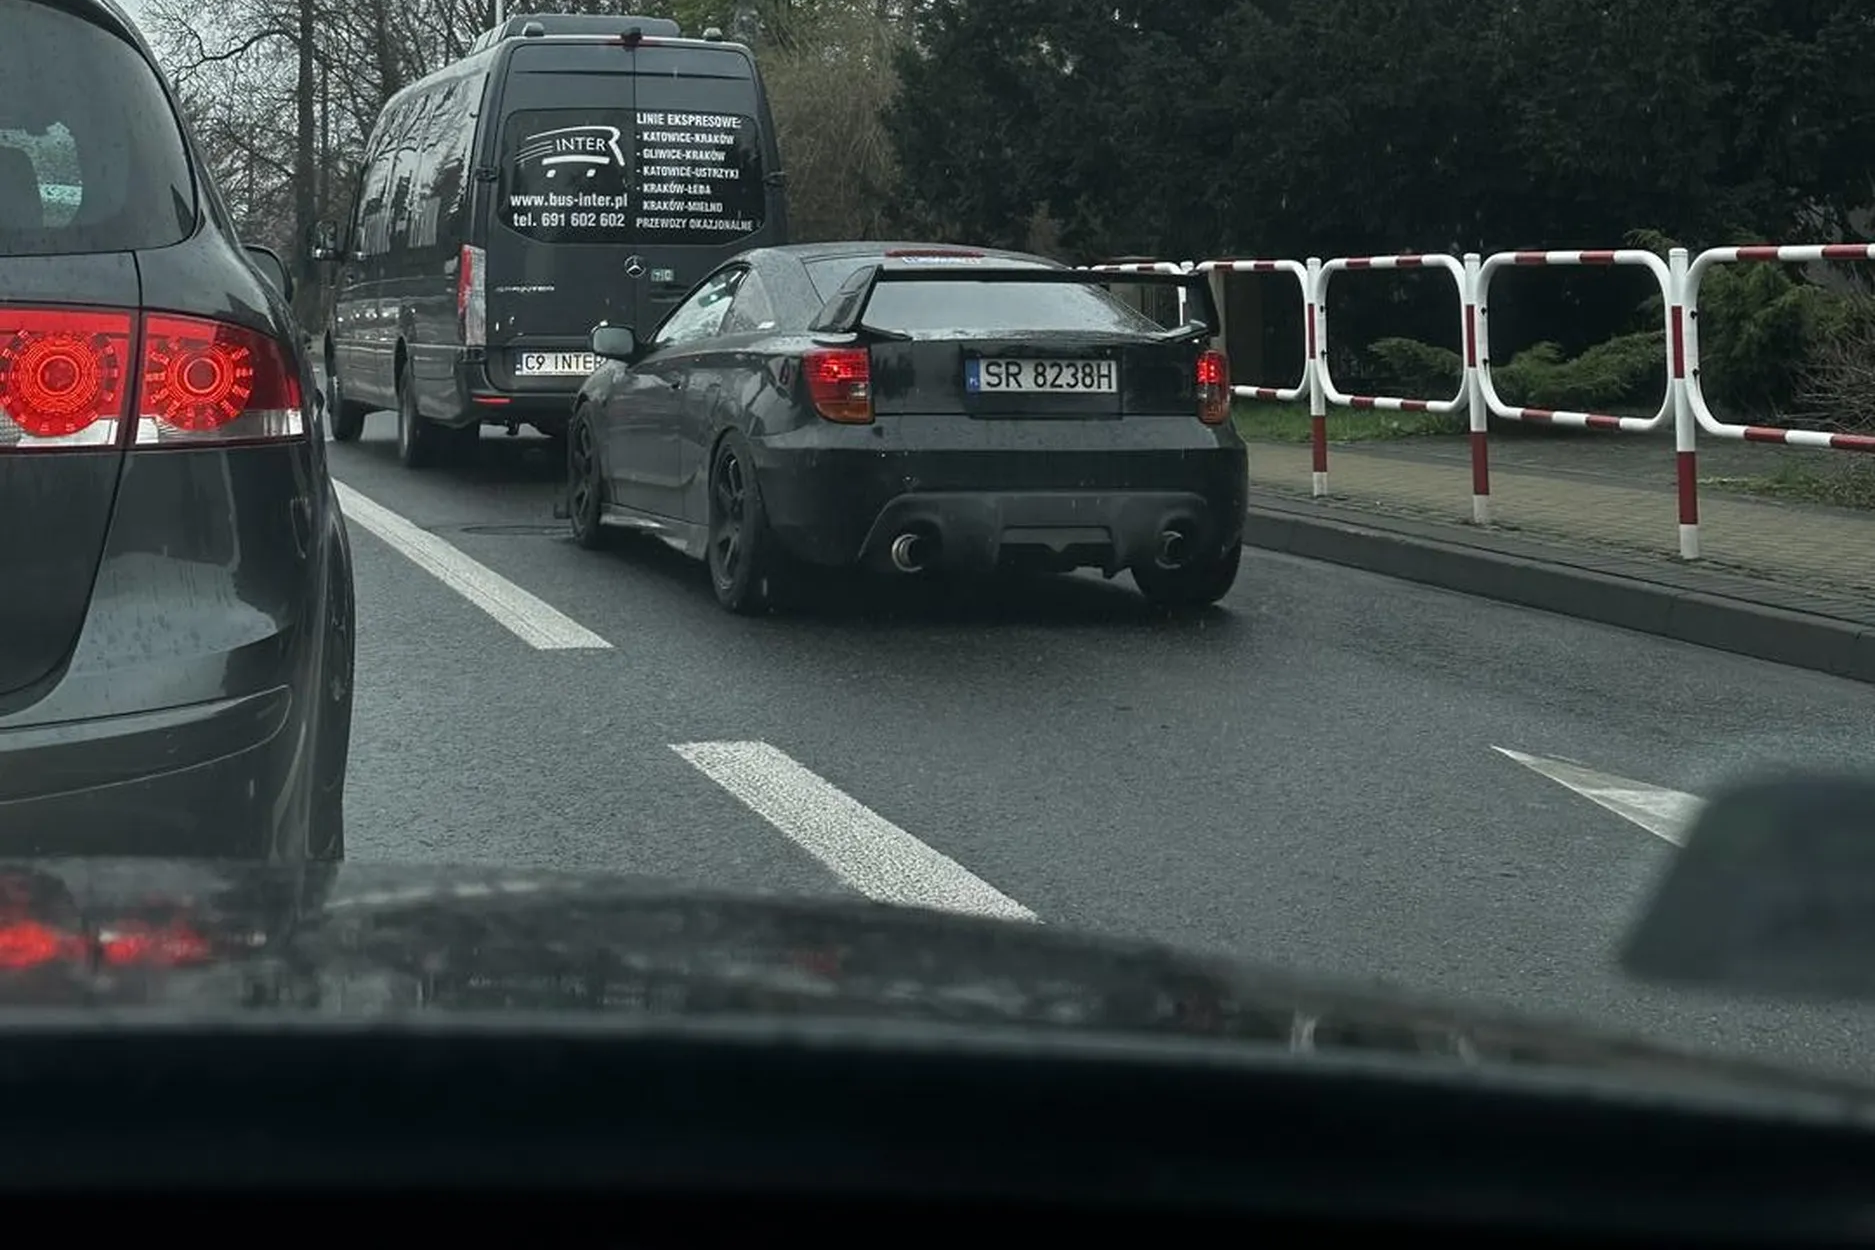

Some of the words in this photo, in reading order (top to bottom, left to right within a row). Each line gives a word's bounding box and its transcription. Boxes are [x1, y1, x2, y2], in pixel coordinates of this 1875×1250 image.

[636, 112, 664, 126] LINIE
[556, 137, 606, 151] INTER
[510, 192, 628, 210] www.bus-inter.pl
[513, 212, 537, 227] tel.
[541, 212, 566, 227] 691
[570, 212, 597, 227] 602
[600, 212, 626, 227] 602
[525, 354, 546, 371] C9
[985, 360, 1023, 389] SR
[1033, 361, 1113, 390] 8238H
